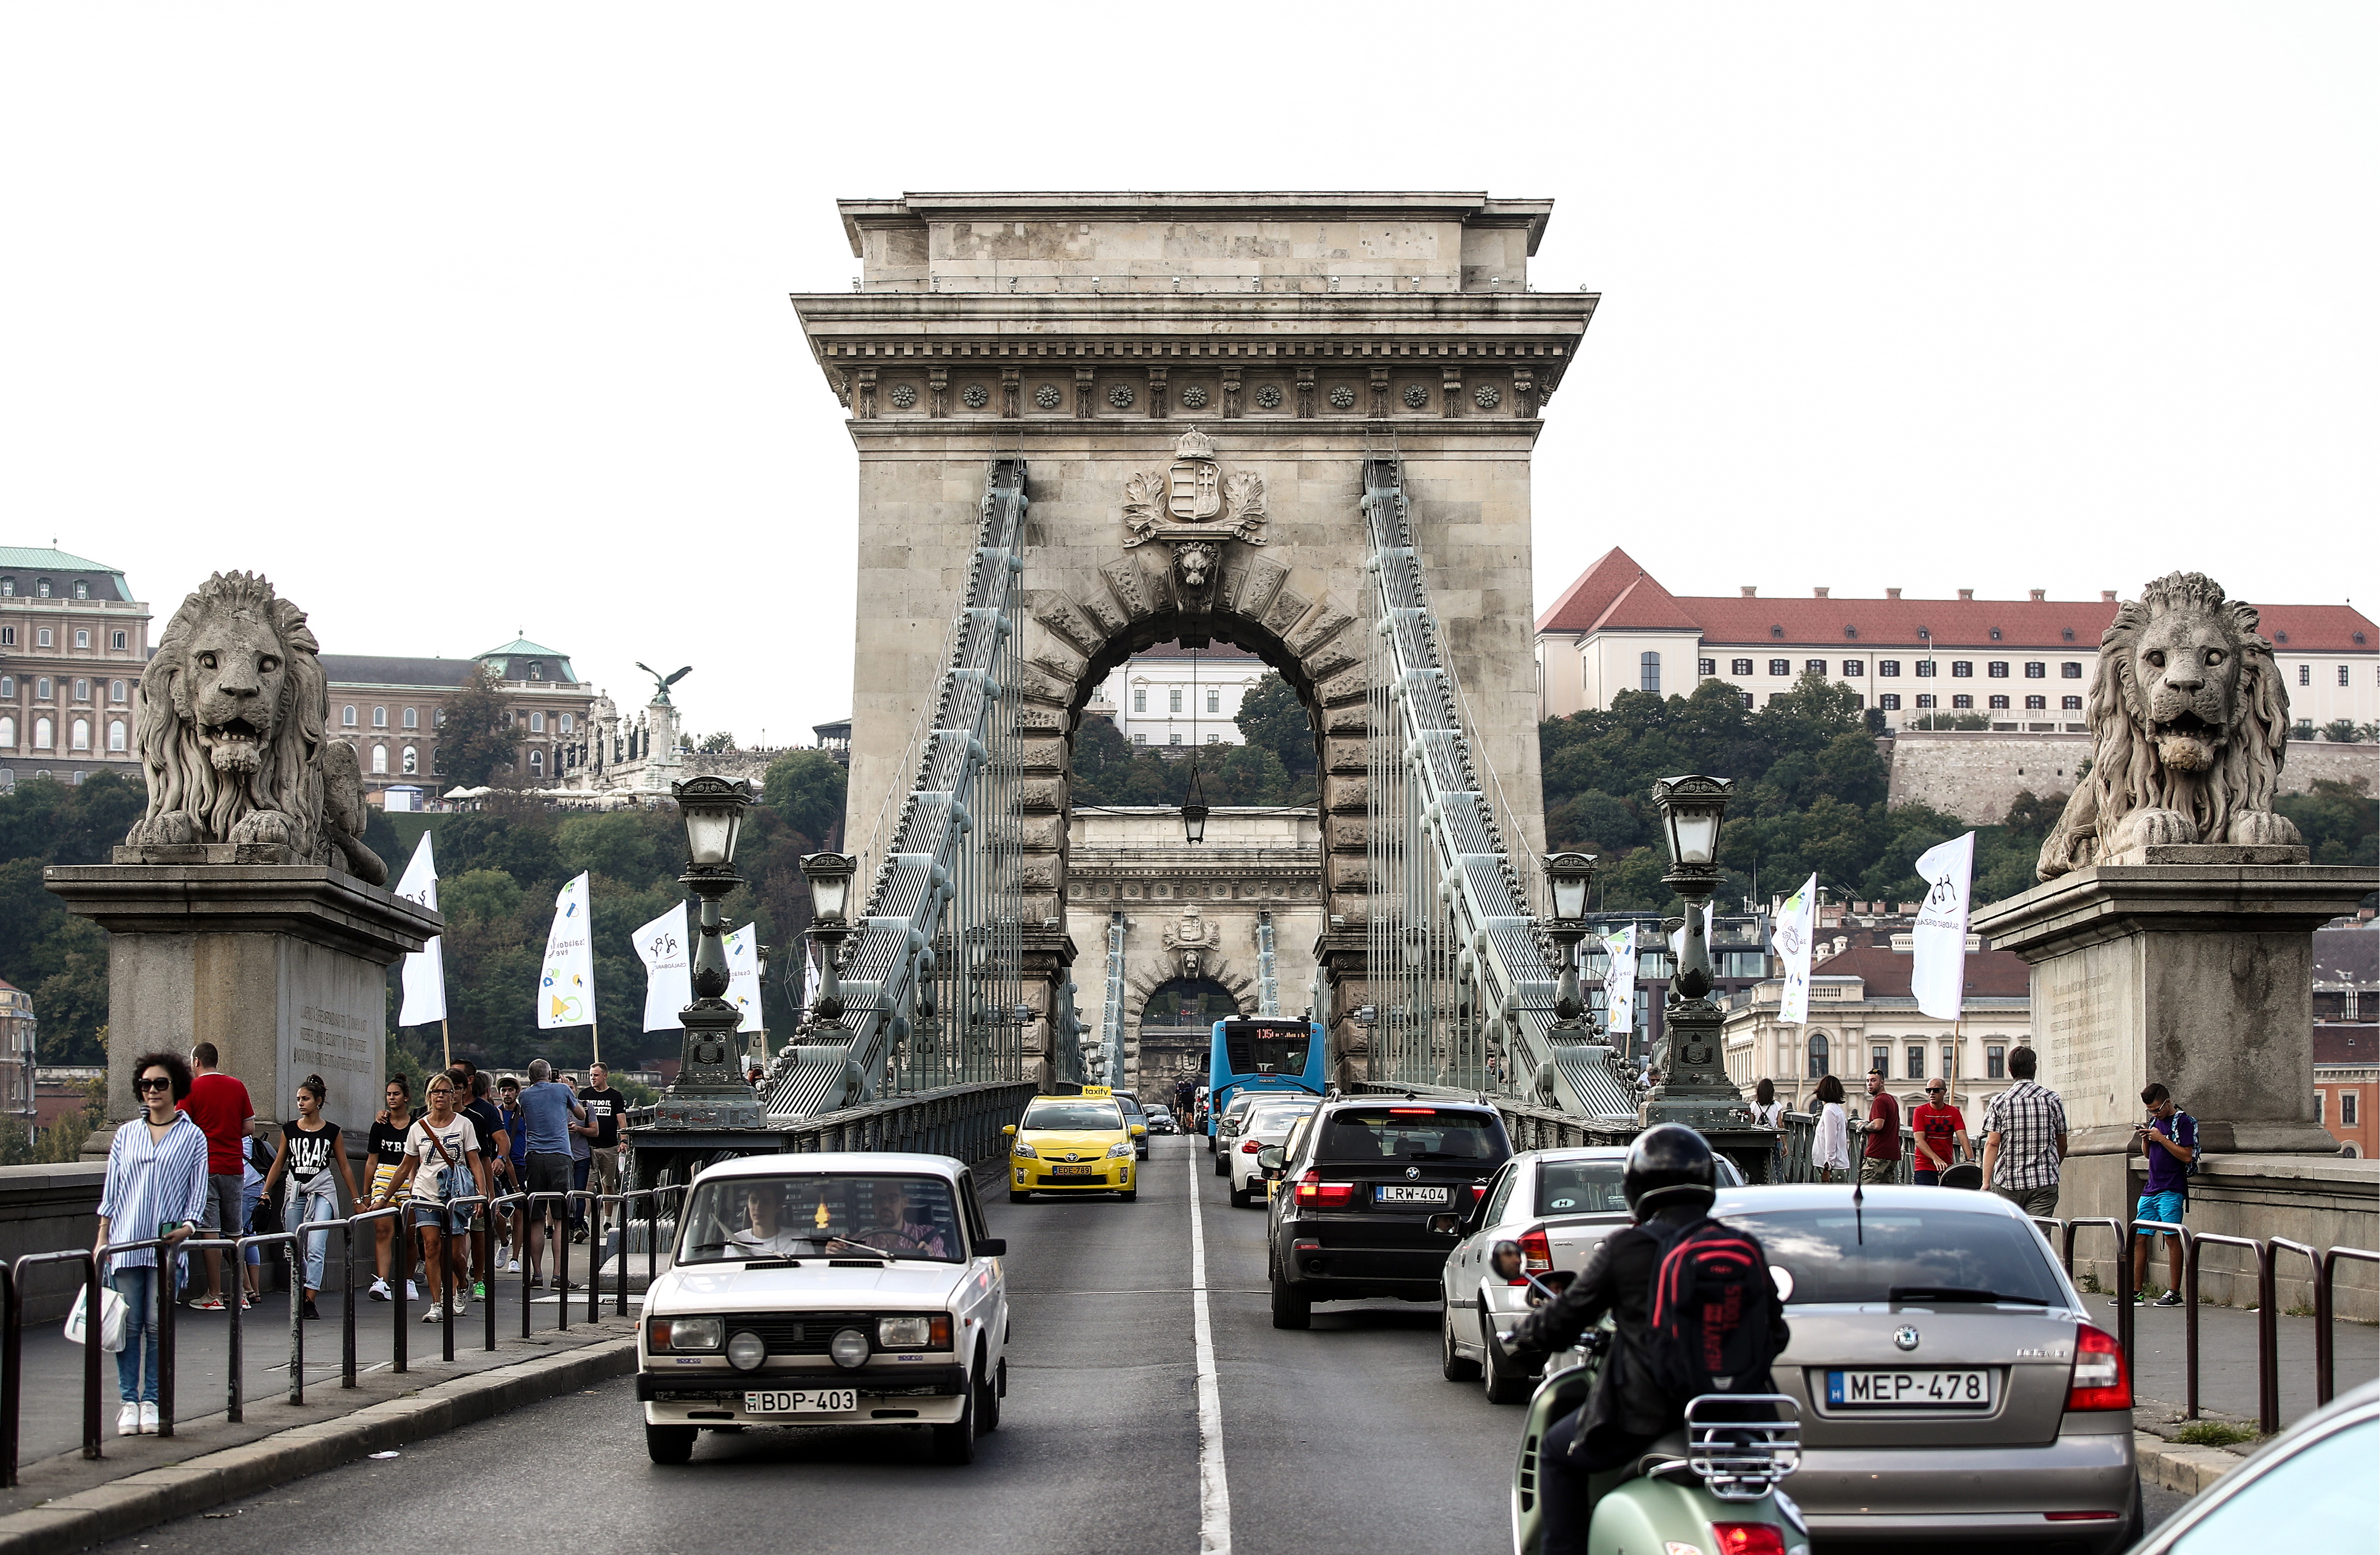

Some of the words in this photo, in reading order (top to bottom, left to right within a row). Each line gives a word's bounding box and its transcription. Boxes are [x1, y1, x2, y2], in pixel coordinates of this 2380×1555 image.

[1085, 1087, 1108, 1096] taxify
[419, 1131, 462, 1166] 75
[1386, 1188, 1444, 1200] LRW-404
[2016, 1348, 2066, 1357] Octavia
[1850, 1374, 1980, 1399] MEP-478
[1832, 1389, 1839, 1399] H
[762, 1391, 853, 1410] BDP-403
